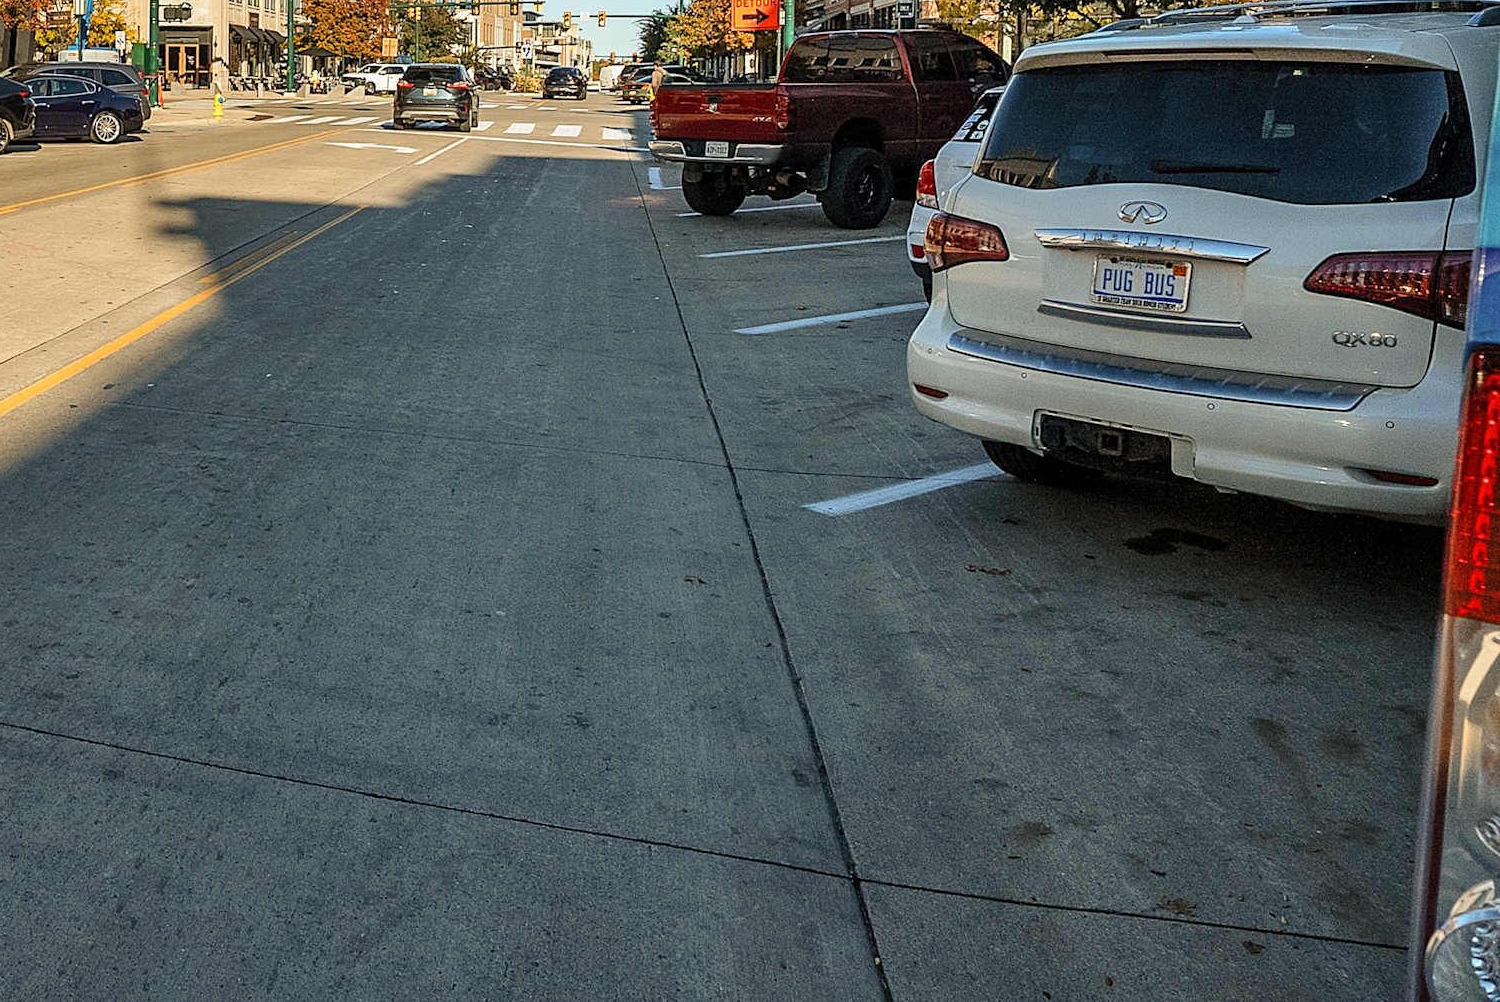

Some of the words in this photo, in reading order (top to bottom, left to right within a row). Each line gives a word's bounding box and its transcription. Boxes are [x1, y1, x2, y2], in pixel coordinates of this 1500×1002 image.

[1102, 268, 1133, 292] PUG
[1144, 272, 1176, 297] BUS
[1332, 331, 1397, 348] QX80
